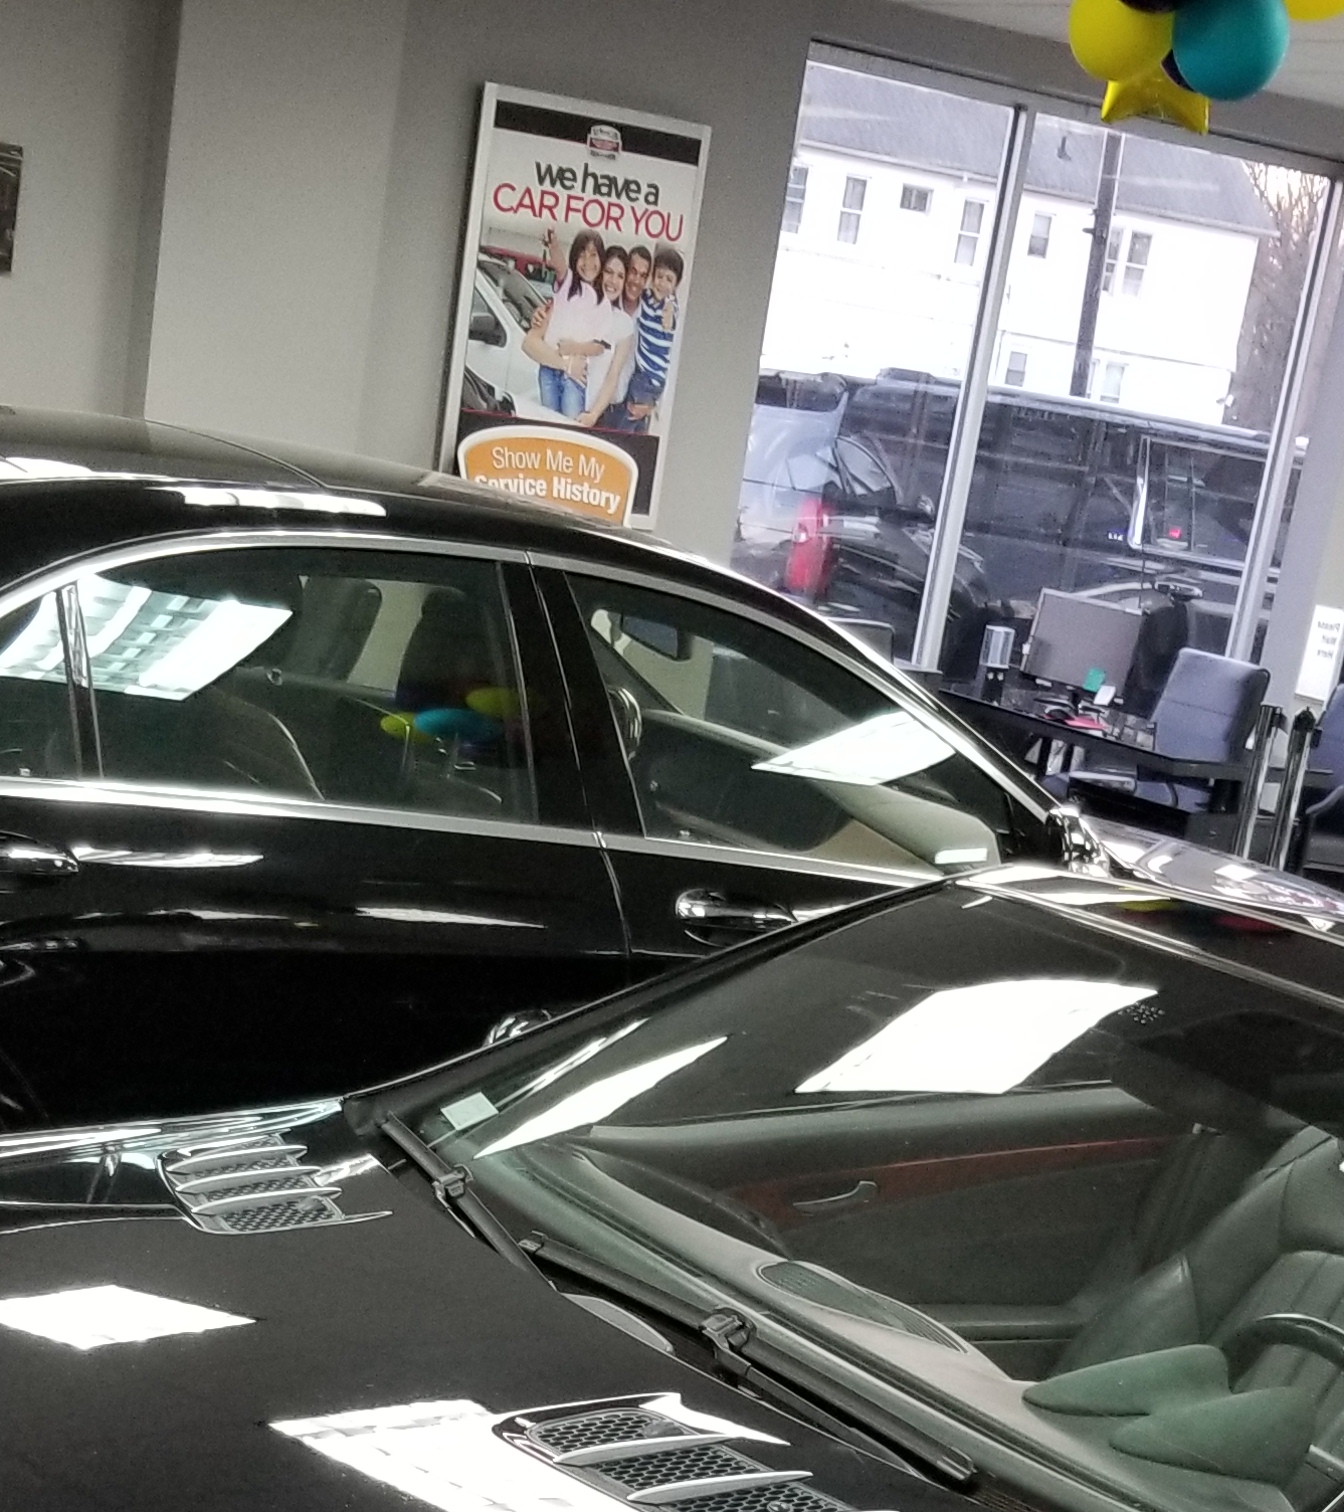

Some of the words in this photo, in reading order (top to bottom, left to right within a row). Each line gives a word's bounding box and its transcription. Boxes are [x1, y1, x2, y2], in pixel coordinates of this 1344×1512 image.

[535, 161, 577, 191] we
[581, 162, 642, 203] have
[644, 182, 660, 207] a
[492, 182, 559, 221] CAR
[563, 193, 625, 232] FOR
[630, 205, 683, 242] YOU
[492, 446, 541, 470] Show
[546, 448, 574, 474] Me
[578, 453, 605, 484] My
[552, 475, 622, 515] History
